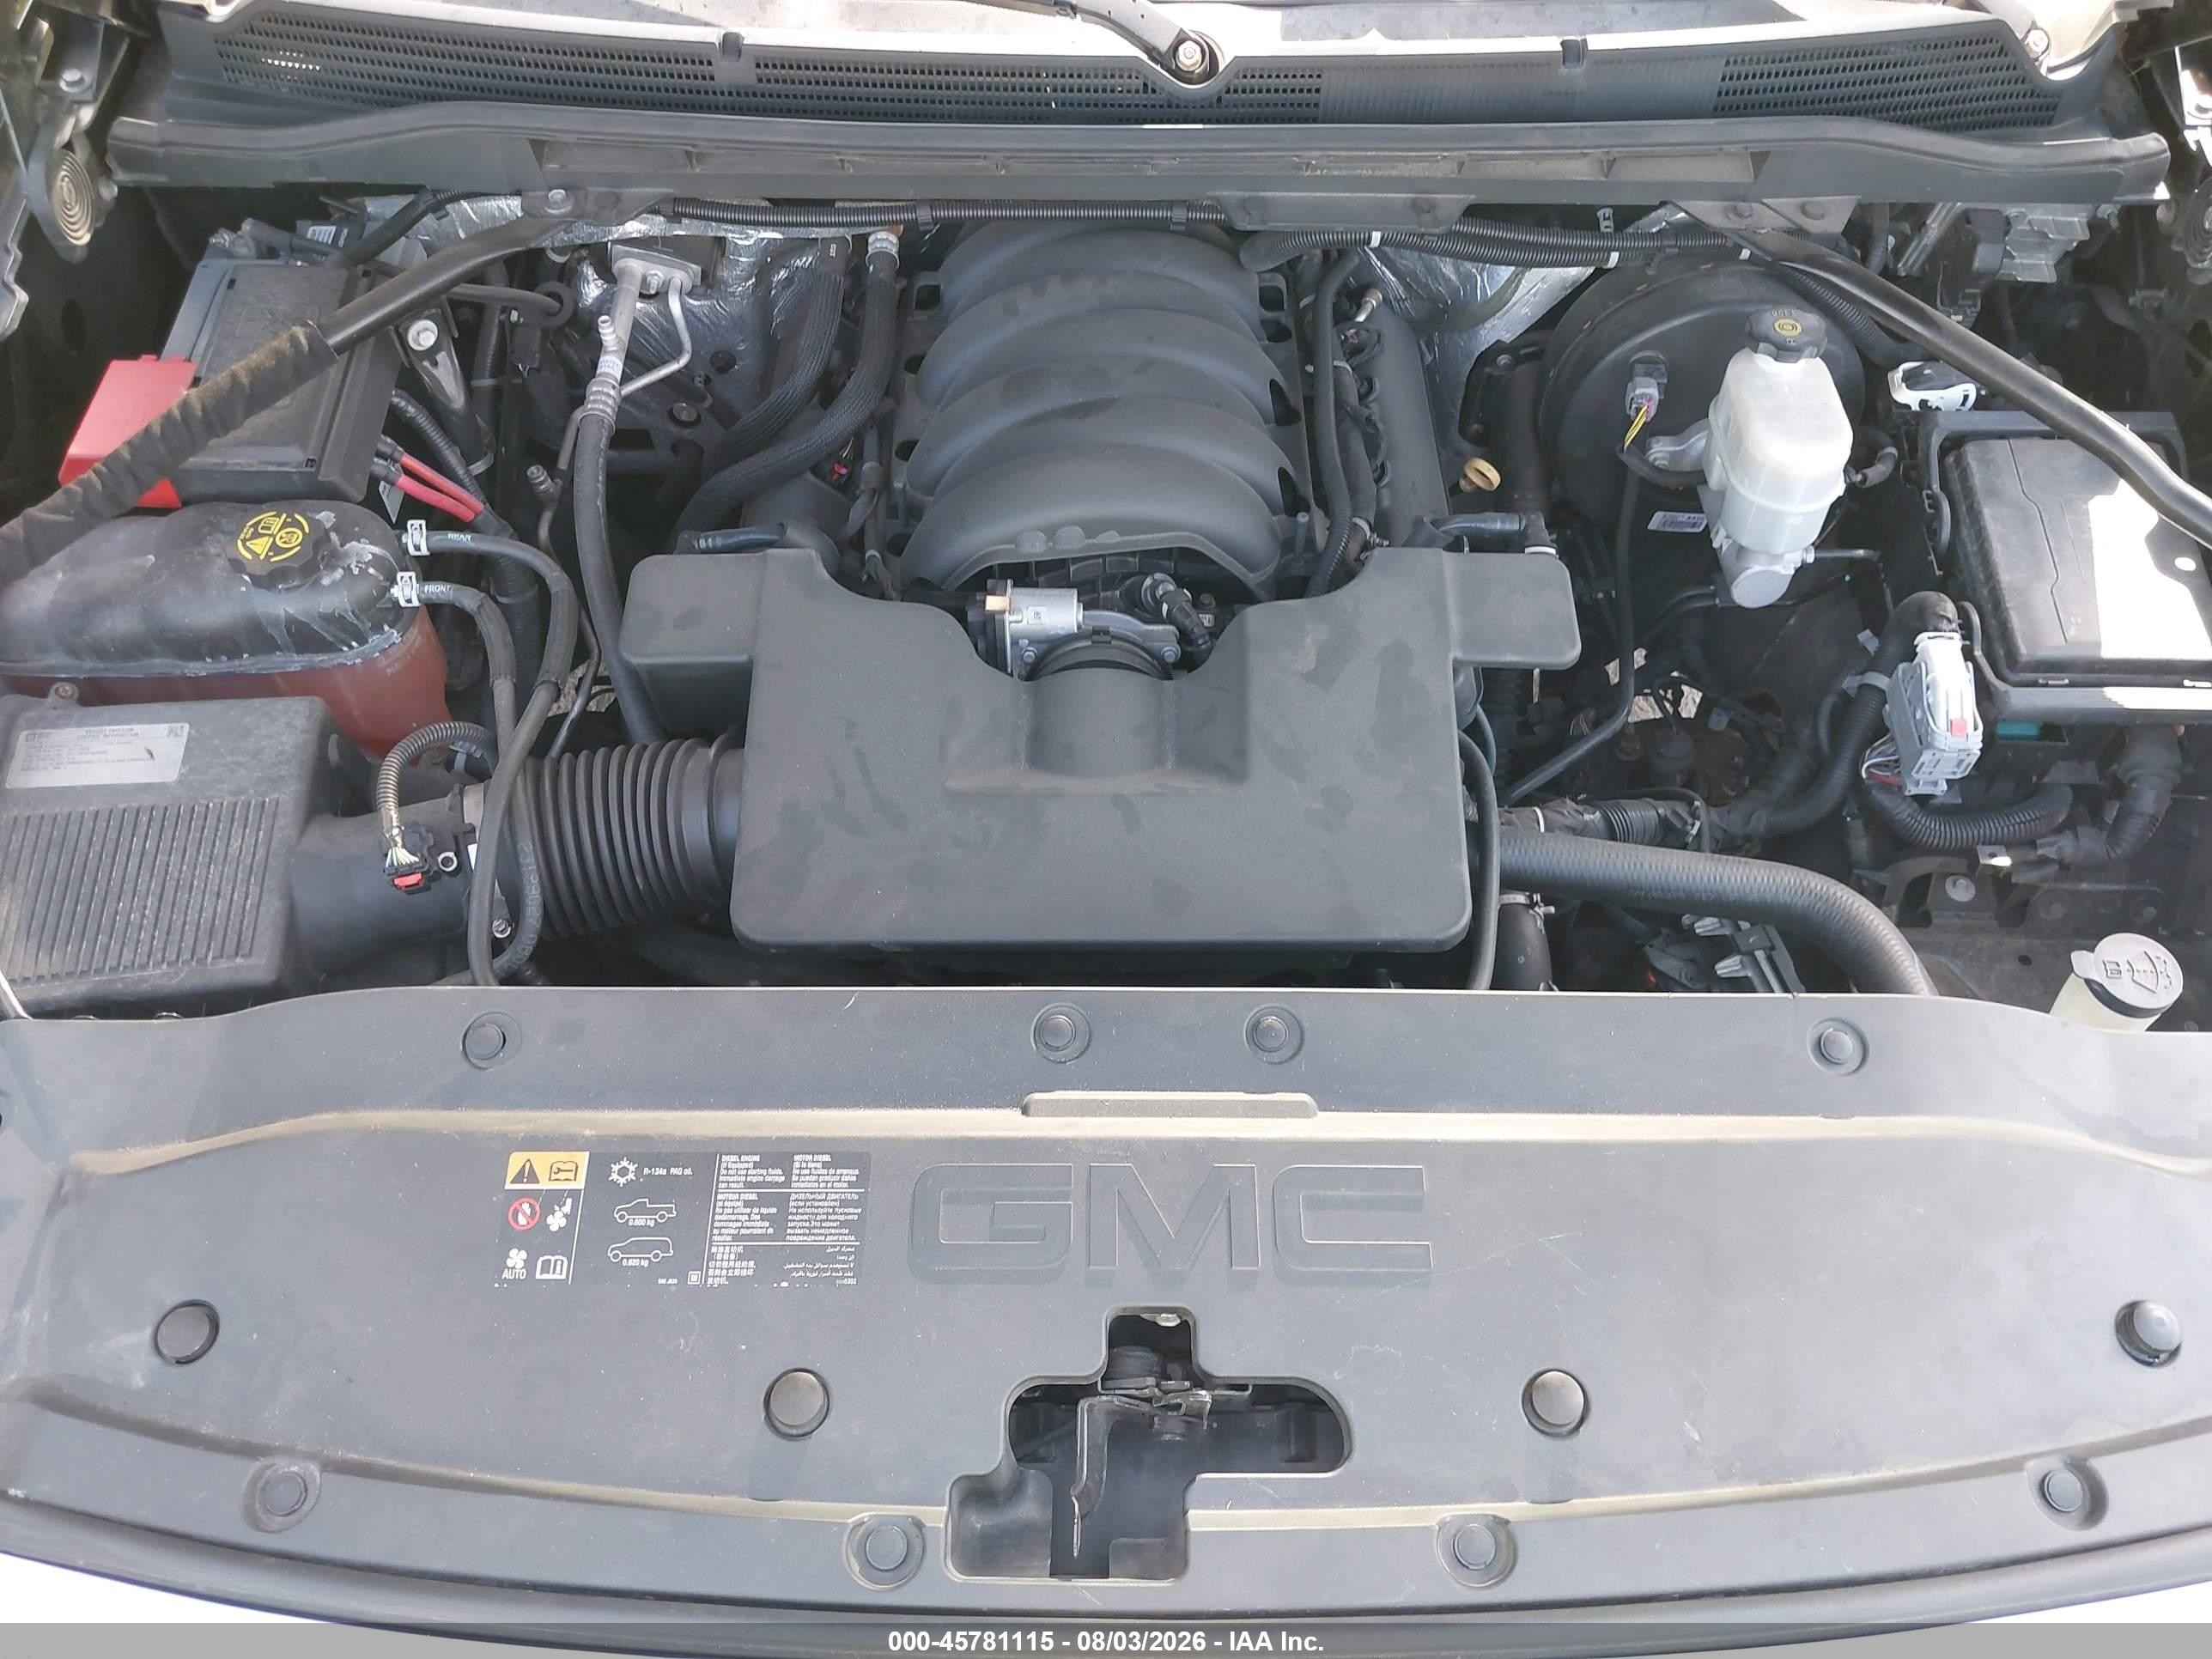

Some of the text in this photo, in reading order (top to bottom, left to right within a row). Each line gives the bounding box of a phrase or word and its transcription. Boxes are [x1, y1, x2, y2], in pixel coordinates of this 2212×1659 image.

[447, 533, 471, 542] REAR
[424, 585, 453, 593] FRONT
[910, 1163, 1433, 1272] GMC
[641, 1259, 648, 1267] kg
[501, 1268, 526, 1279] AUTO
